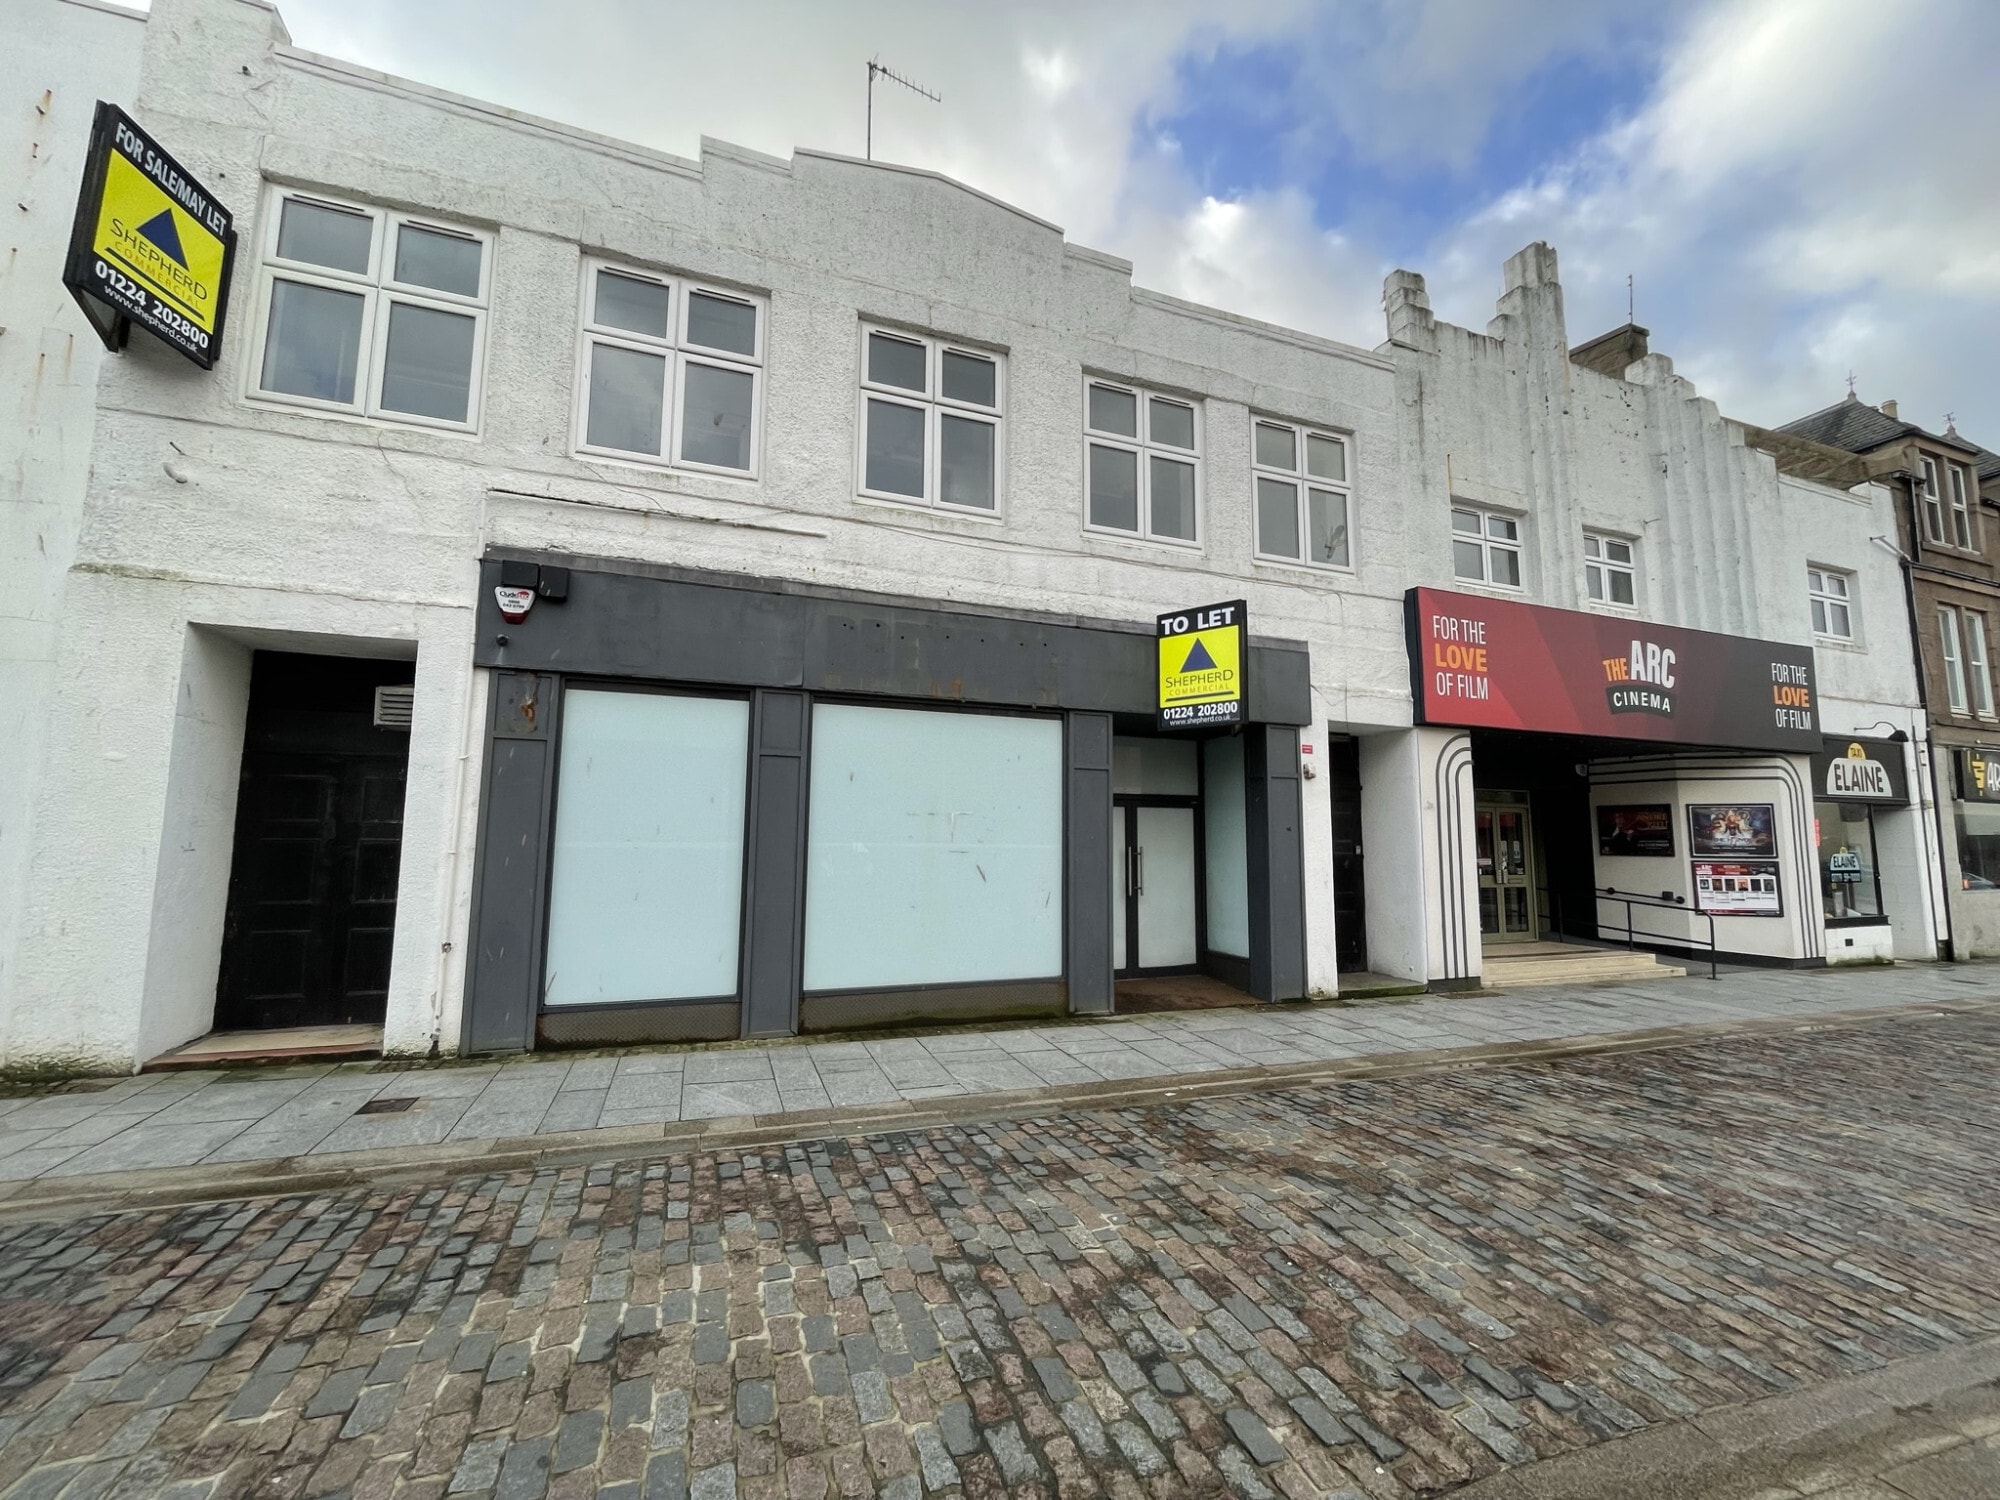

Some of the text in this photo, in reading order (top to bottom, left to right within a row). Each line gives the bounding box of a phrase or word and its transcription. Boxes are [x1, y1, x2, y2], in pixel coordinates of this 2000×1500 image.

[115, 121, 145, 163] FOR
[206, 205, 227, 237] LET
[110, 218, 208, 301] SHEPHERD
[114, 241, 201, 309] COMMERCIAL
[95, 260, 209, 349] 01224 202800
[103, 285, 198, 354] www.shepherd.co.uk
[1161, 606, 1236, 636] TO LET
[1432, 614, 1487, 645] FOR THE
[1434, 642, 1488, 673] LOVE
[1602, 639, 1676, 689] THE ARC
[1165, 669, 1234, 689] SHEPHERD
[1436, 671, 1489, 701] OF FILM
[1771, 662, 1809, 686] FOR THE
[1168, 683, 1231, 697] COMMERCIAL
[1613, 691, 1671, 713] CINEMA
[1773, 684, 1811, 708] LOVE
[1163, 701, 1238, 720] 01224 202800
[1169, 714, 1231, 727] www.shepherd.co.uk
[1775, 708, 1812, 731] OF FILM
[1833, 763, 1884, 793] ELAINE
[1833, 855, 1857, 868] ELAINE
